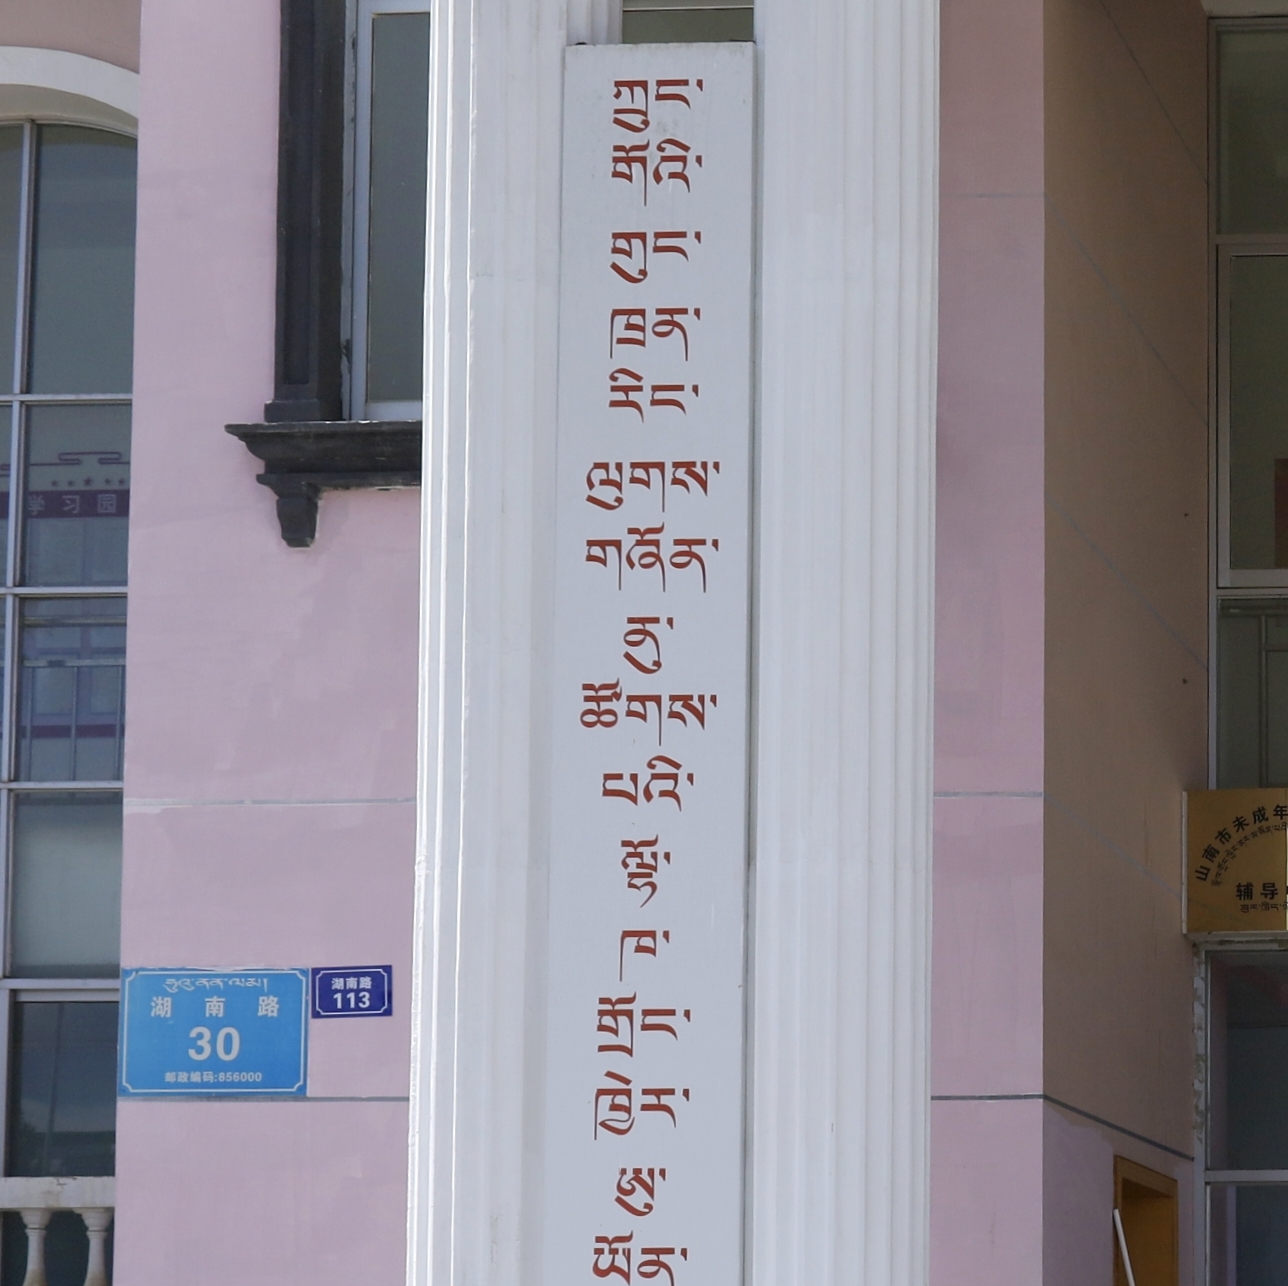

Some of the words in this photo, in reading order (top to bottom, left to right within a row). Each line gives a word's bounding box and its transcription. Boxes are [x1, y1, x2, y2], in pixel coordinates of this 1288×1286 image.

[330, 976, 373, 990] 湖南路
[150, 995, 280, 1018] 湖南路
[333, 991, 371, 1010] 113
[188, 1026, 241, 1062] 30
